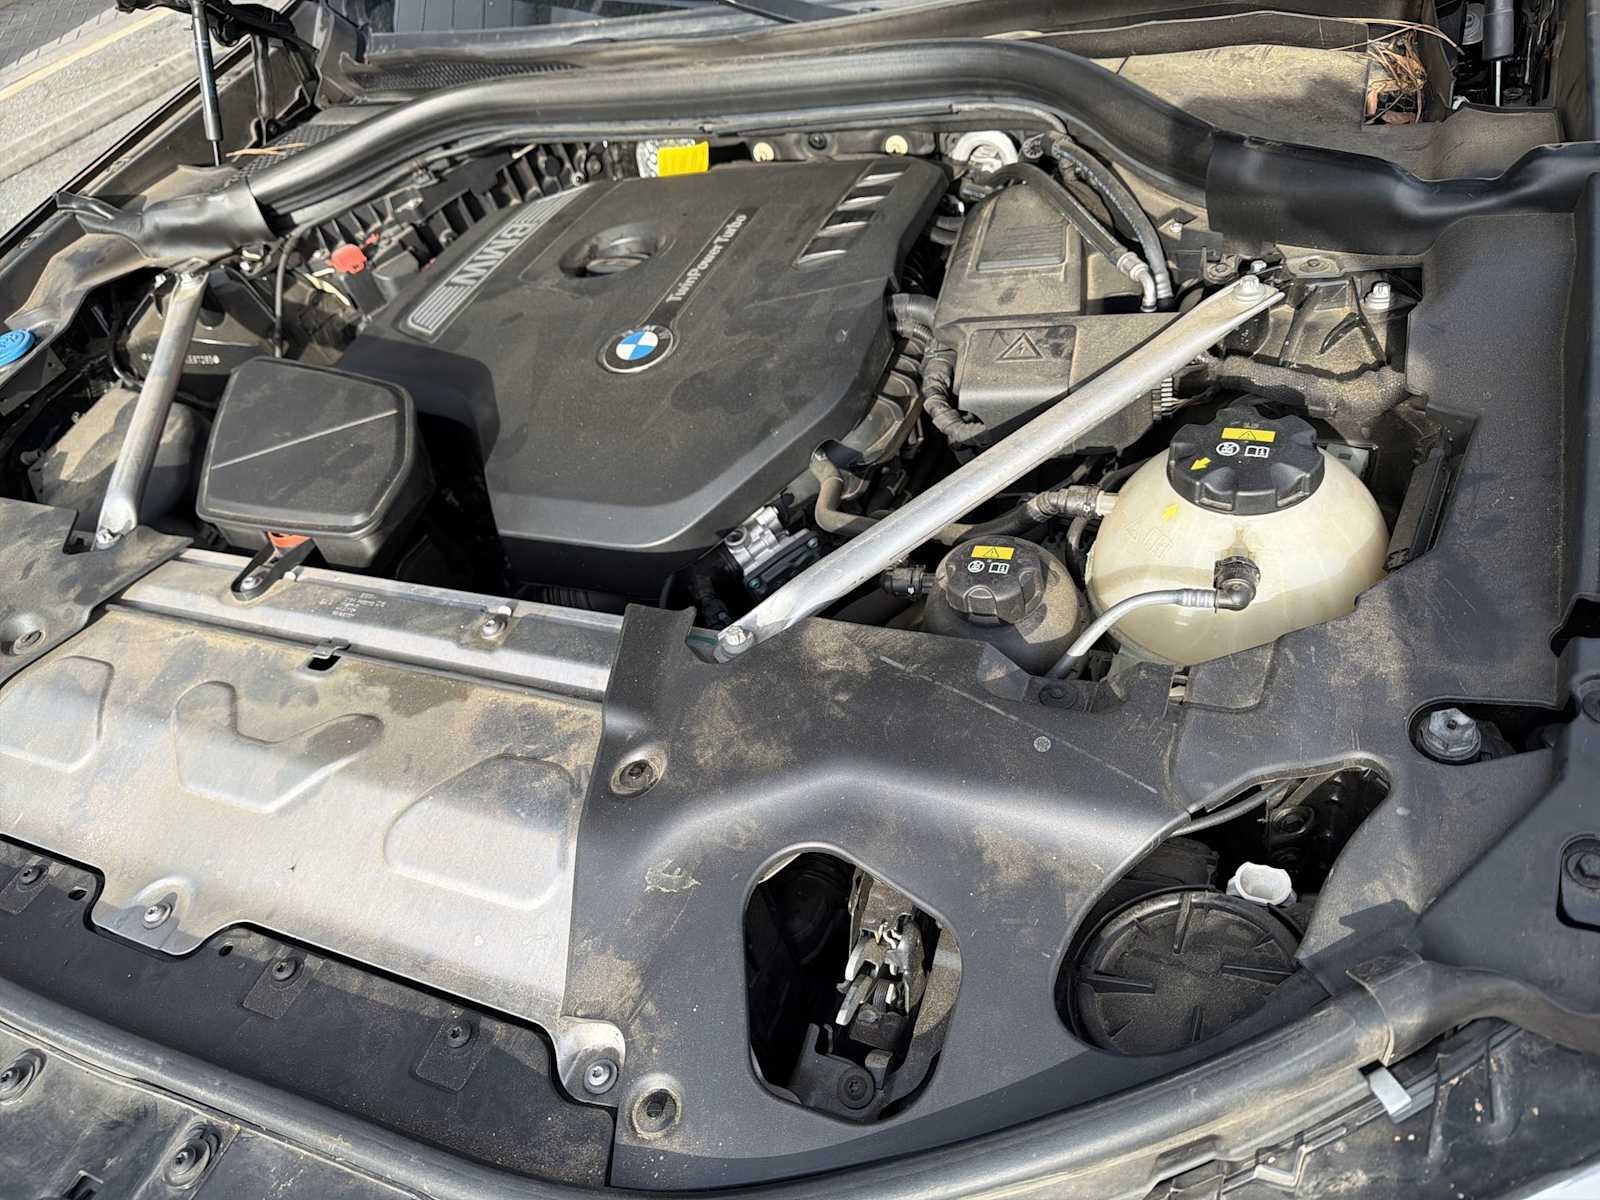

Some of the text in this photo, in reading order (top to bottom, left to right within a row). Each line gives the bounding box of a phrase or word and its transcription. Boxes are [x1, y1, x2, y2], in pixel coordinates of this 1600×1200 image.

[450, 223, 538, 286] BMW
[665, 214, 747, 303] TwinPower Turbo
